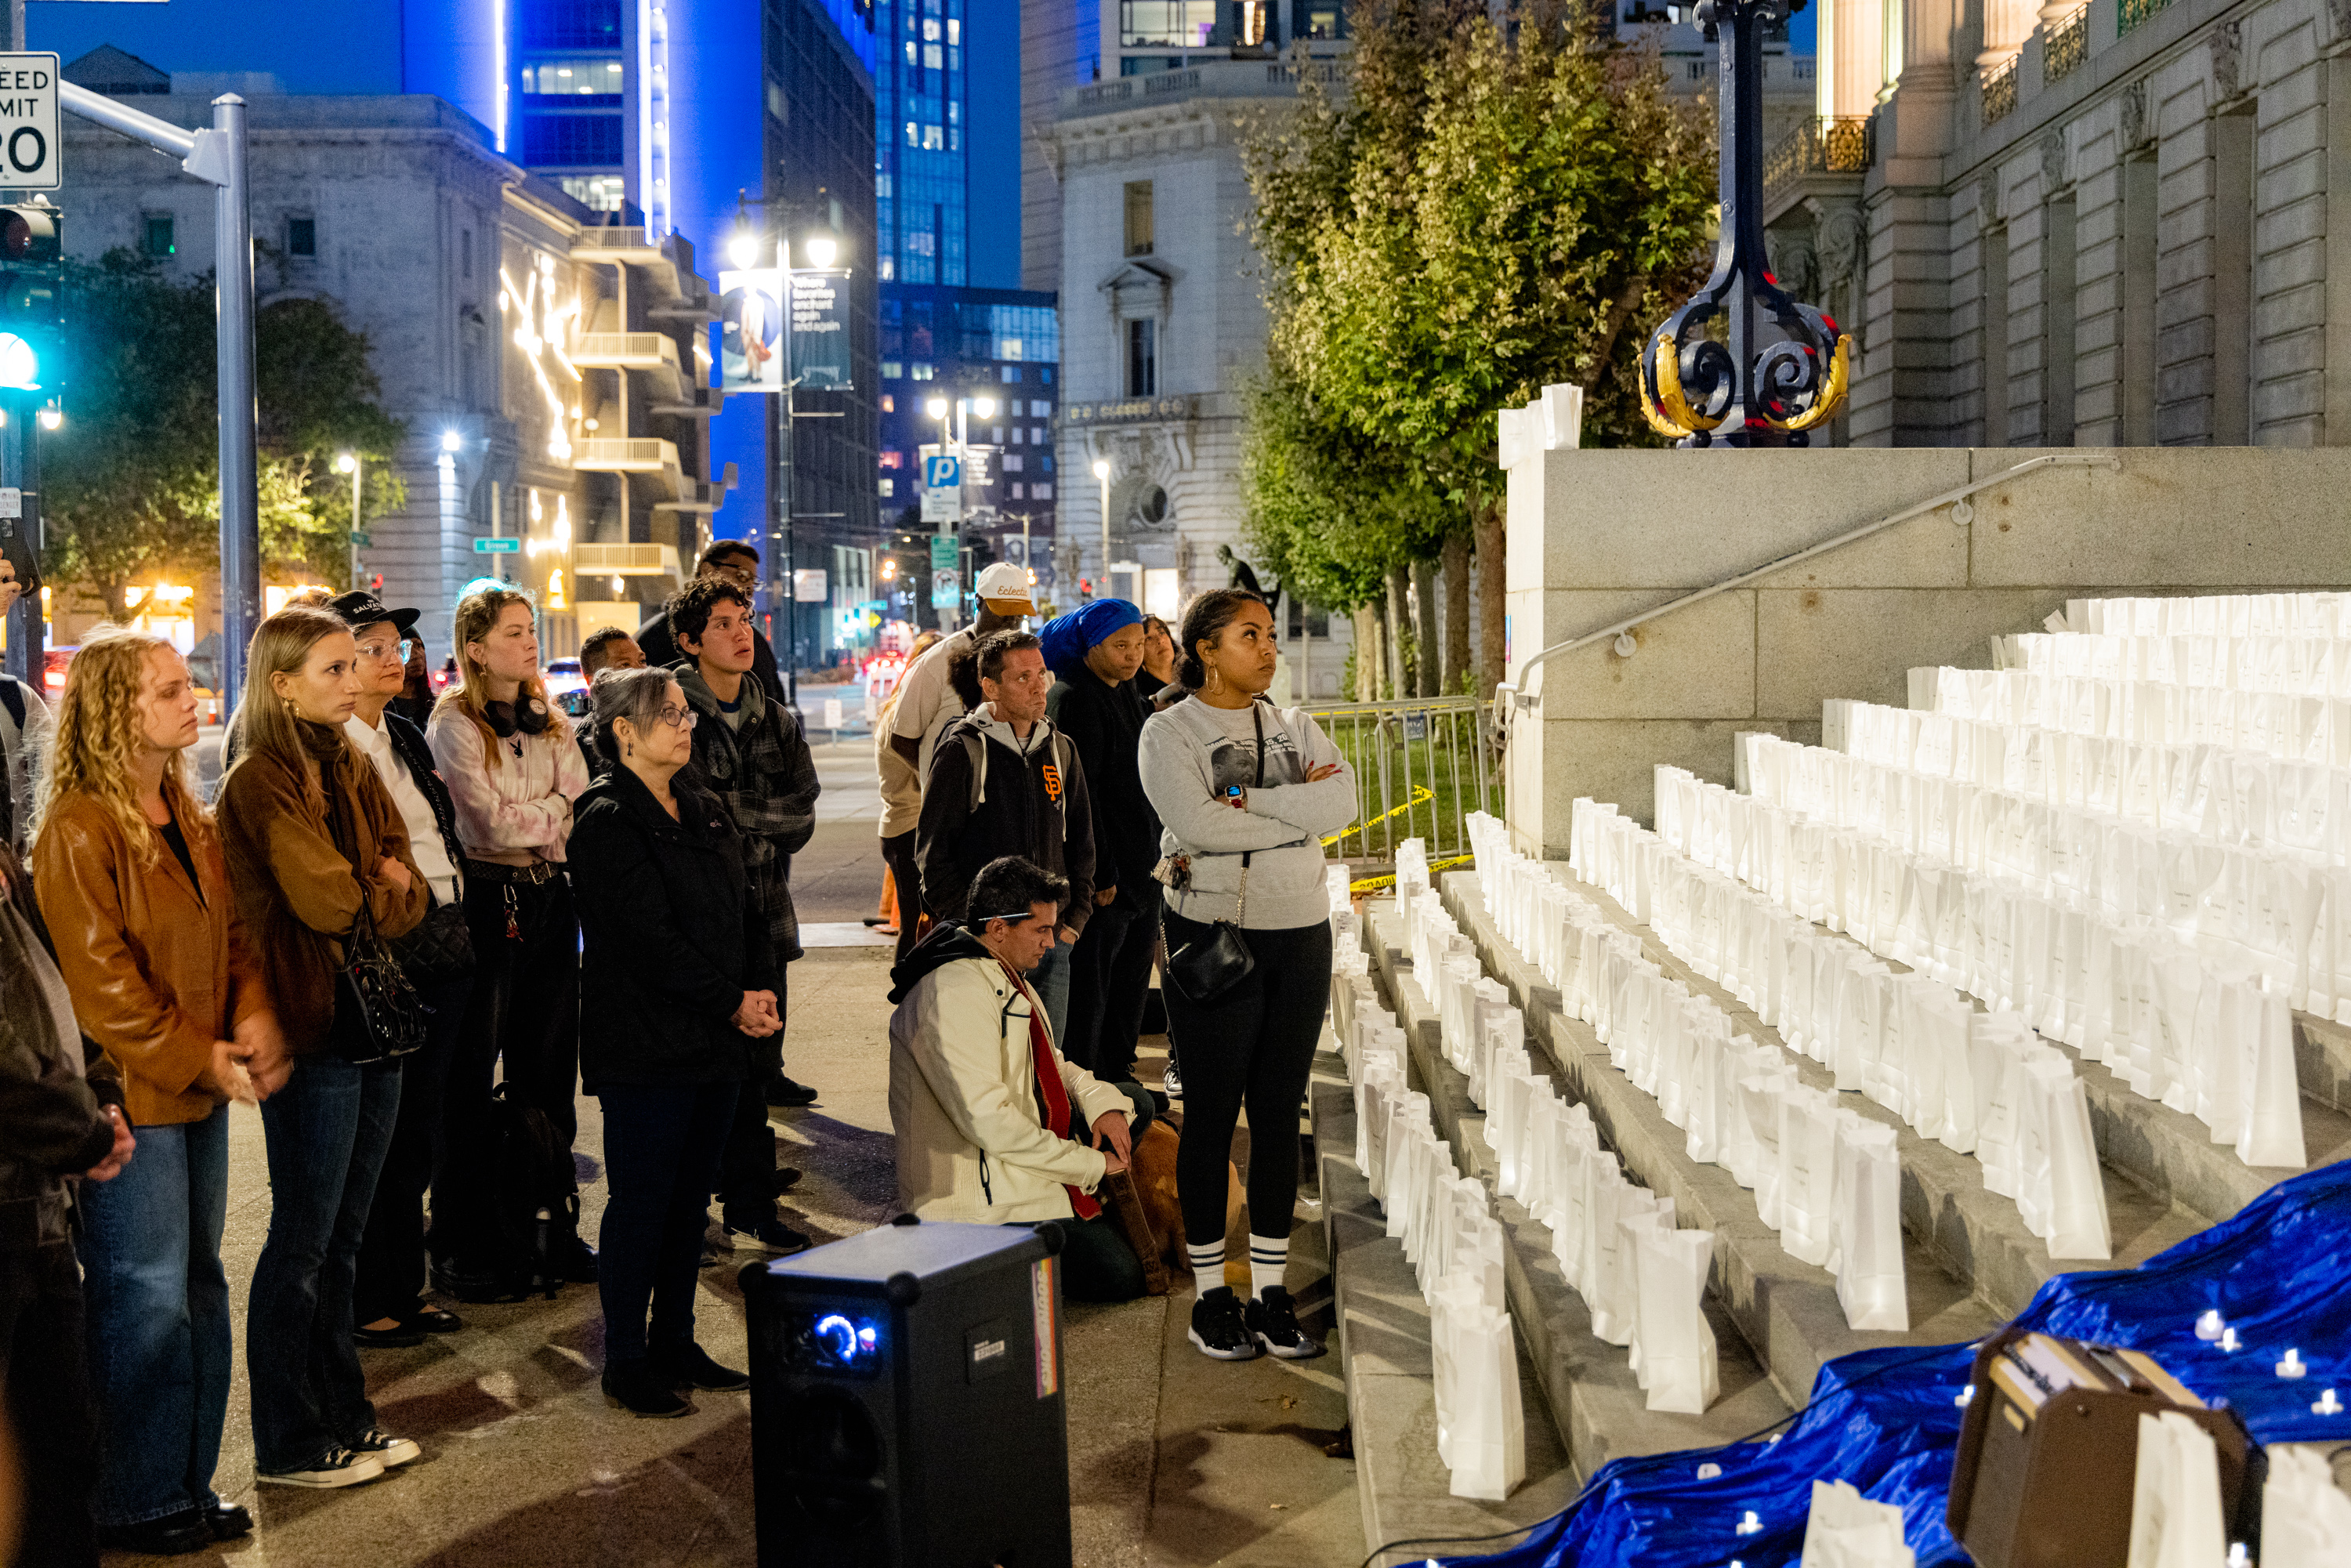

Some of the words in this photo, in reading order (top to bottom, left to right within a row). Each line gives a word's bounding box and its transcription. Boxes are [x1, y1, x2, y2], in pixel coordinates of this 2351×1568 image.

[0, 126, 46, 173] 0
[792, 311, 820, 322] again
[792, 321, 812, 331] and
[813, 321, 840, 333] again
